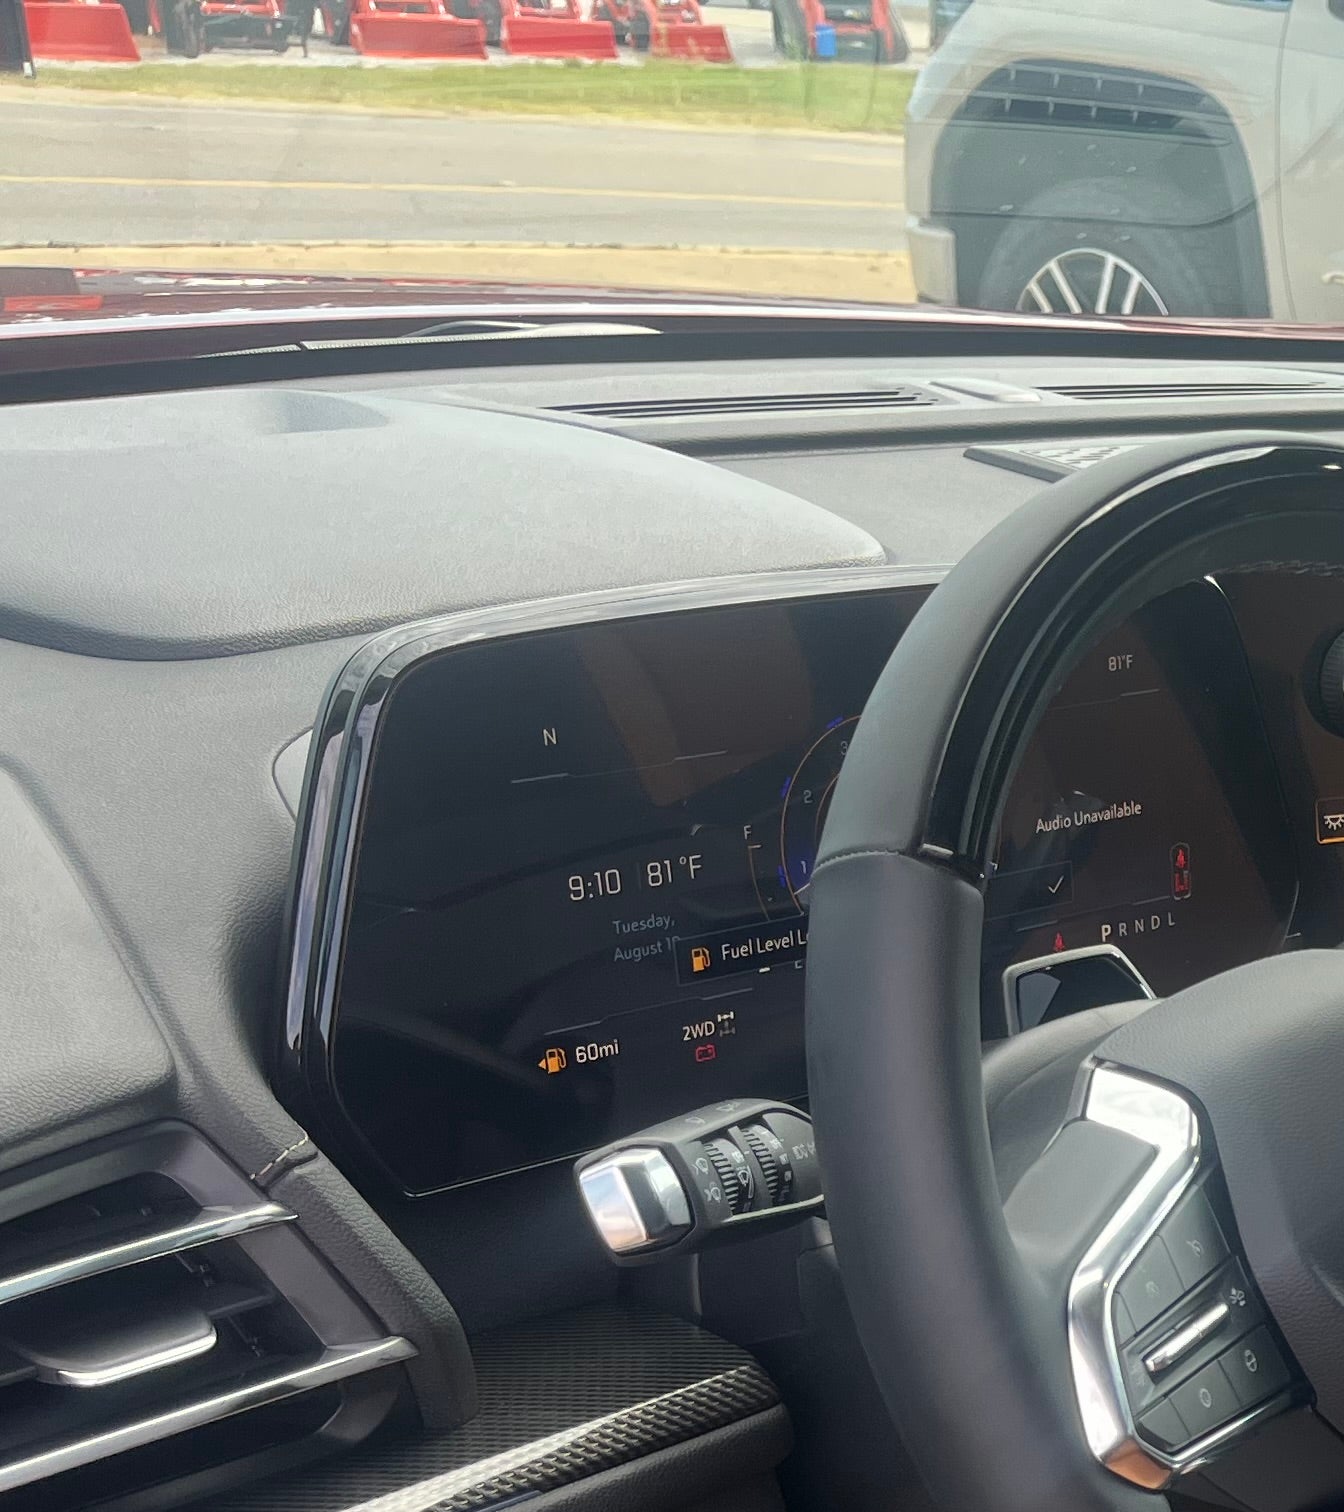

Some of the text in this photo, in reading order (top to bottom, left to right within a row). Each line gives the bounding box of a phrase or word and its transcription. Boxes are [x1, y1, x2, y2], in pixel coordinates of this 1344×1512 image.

[542, 728, 558, 746] N
[803, 789, 812, 804] 2
[1036, 800, 1142, 834] Audio Unavailable
[568, 868, 622, 901] 9:10
[612, 913, 675, 935] Tuesday,
[1101, 911, 1176, 943] P R N D L
[613, 940, 664, 963] August
[721, 937, 754, 961] Fuel
[756, 929, 795, 954] Level
[682, 1019, 715, 1042] 2WD
[575, 1039, 620, 1065] 60mi
